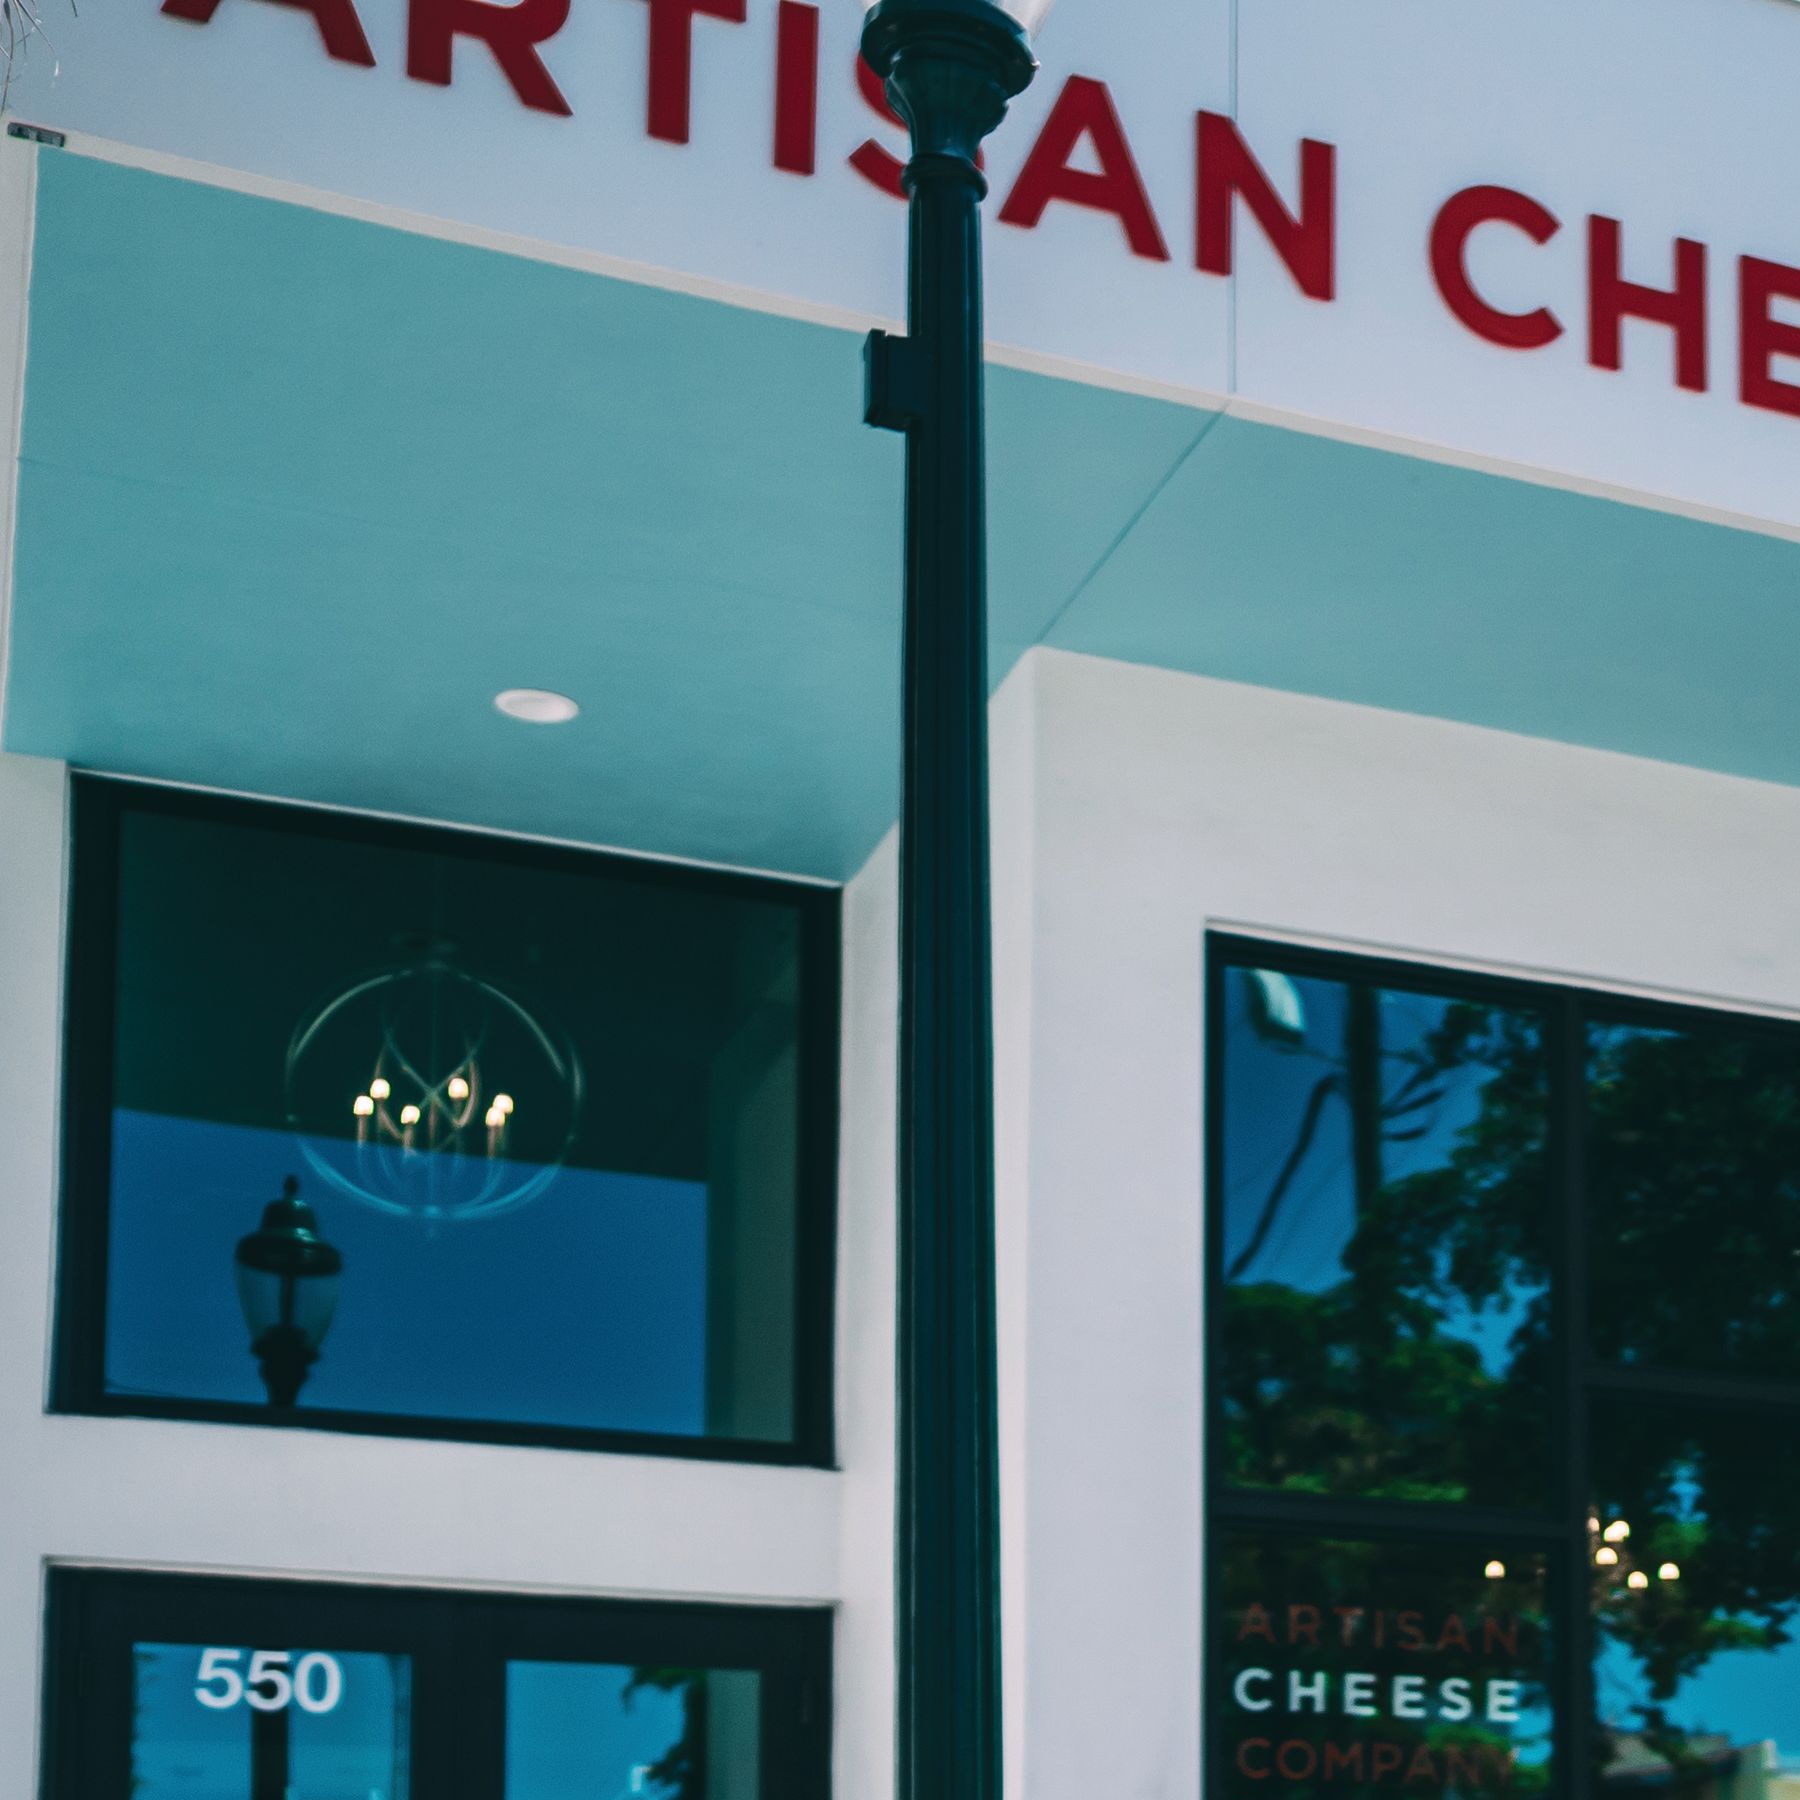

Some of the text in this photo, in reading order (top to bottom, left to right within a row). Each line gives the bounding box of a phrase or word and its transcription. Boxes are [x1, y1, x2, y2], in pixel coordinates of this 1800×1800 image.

[1237, 1602, 1518, 1655] ARTISAN
[194, 1647, 342, 1713] 550
[1233, 1667, 1521, 1722] CHEESE
